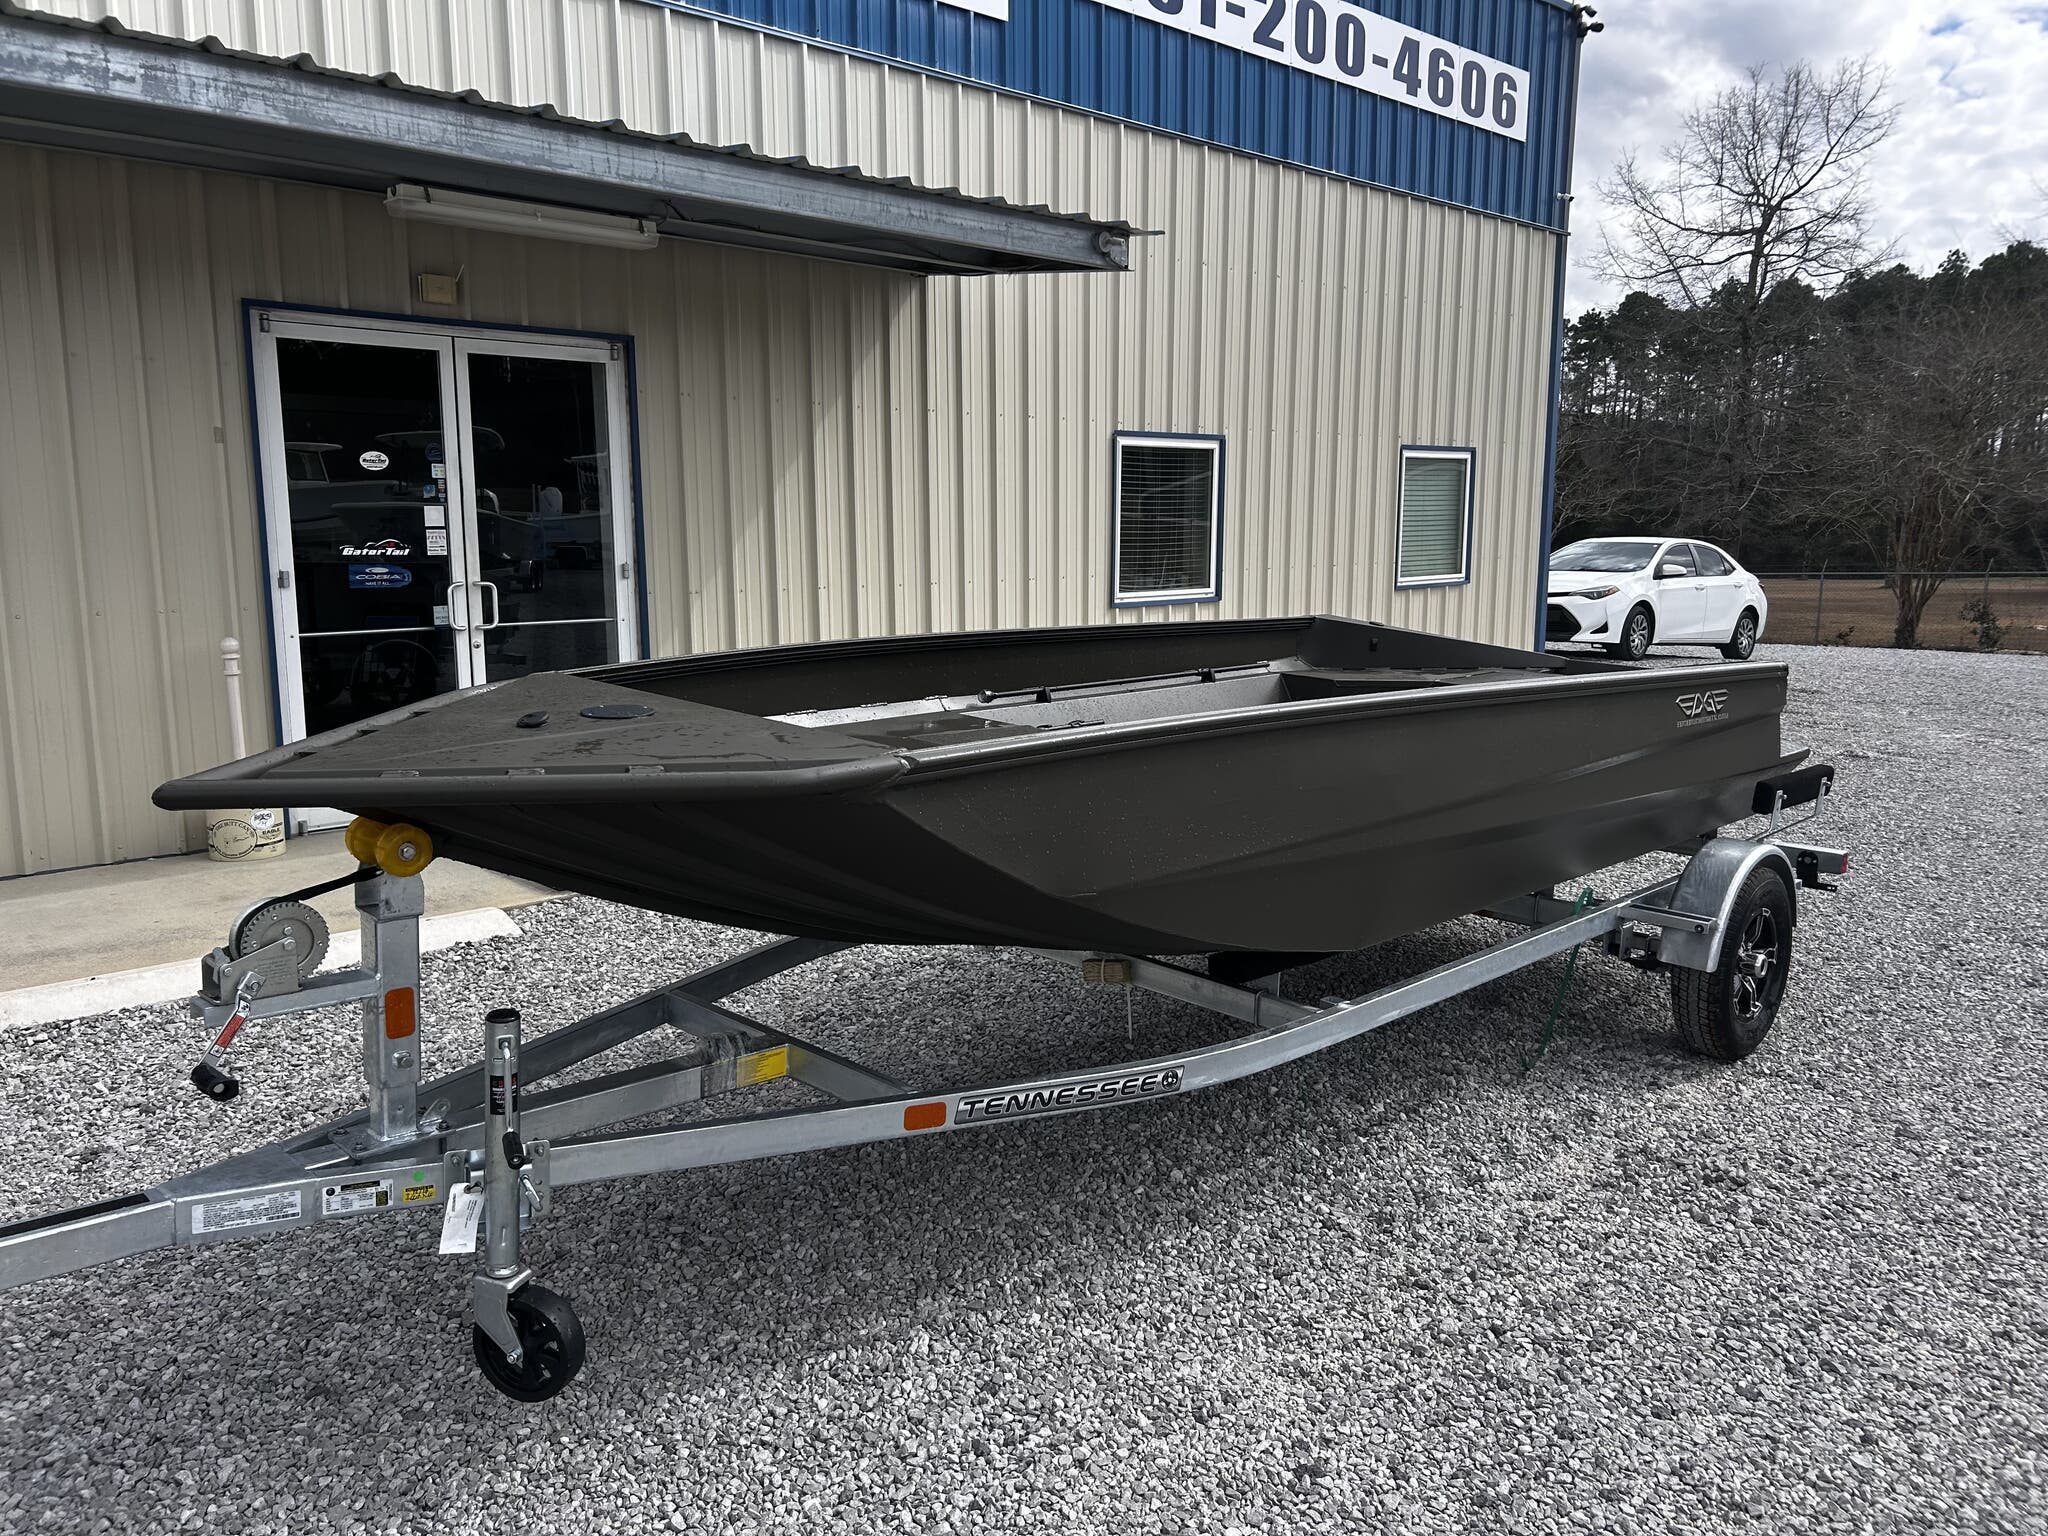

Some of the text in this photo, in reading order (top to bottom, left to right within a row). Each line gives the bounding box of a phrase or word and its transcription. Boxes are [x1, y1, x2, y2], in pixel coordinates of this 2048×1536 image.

[1148, 0, 1518, 129] -200-4606
[342, 547, 410, 556] GatorTail
[262, 827, 280, 835] EAGLE
[963, 1074, 1159, 1118] TENNESSEE
